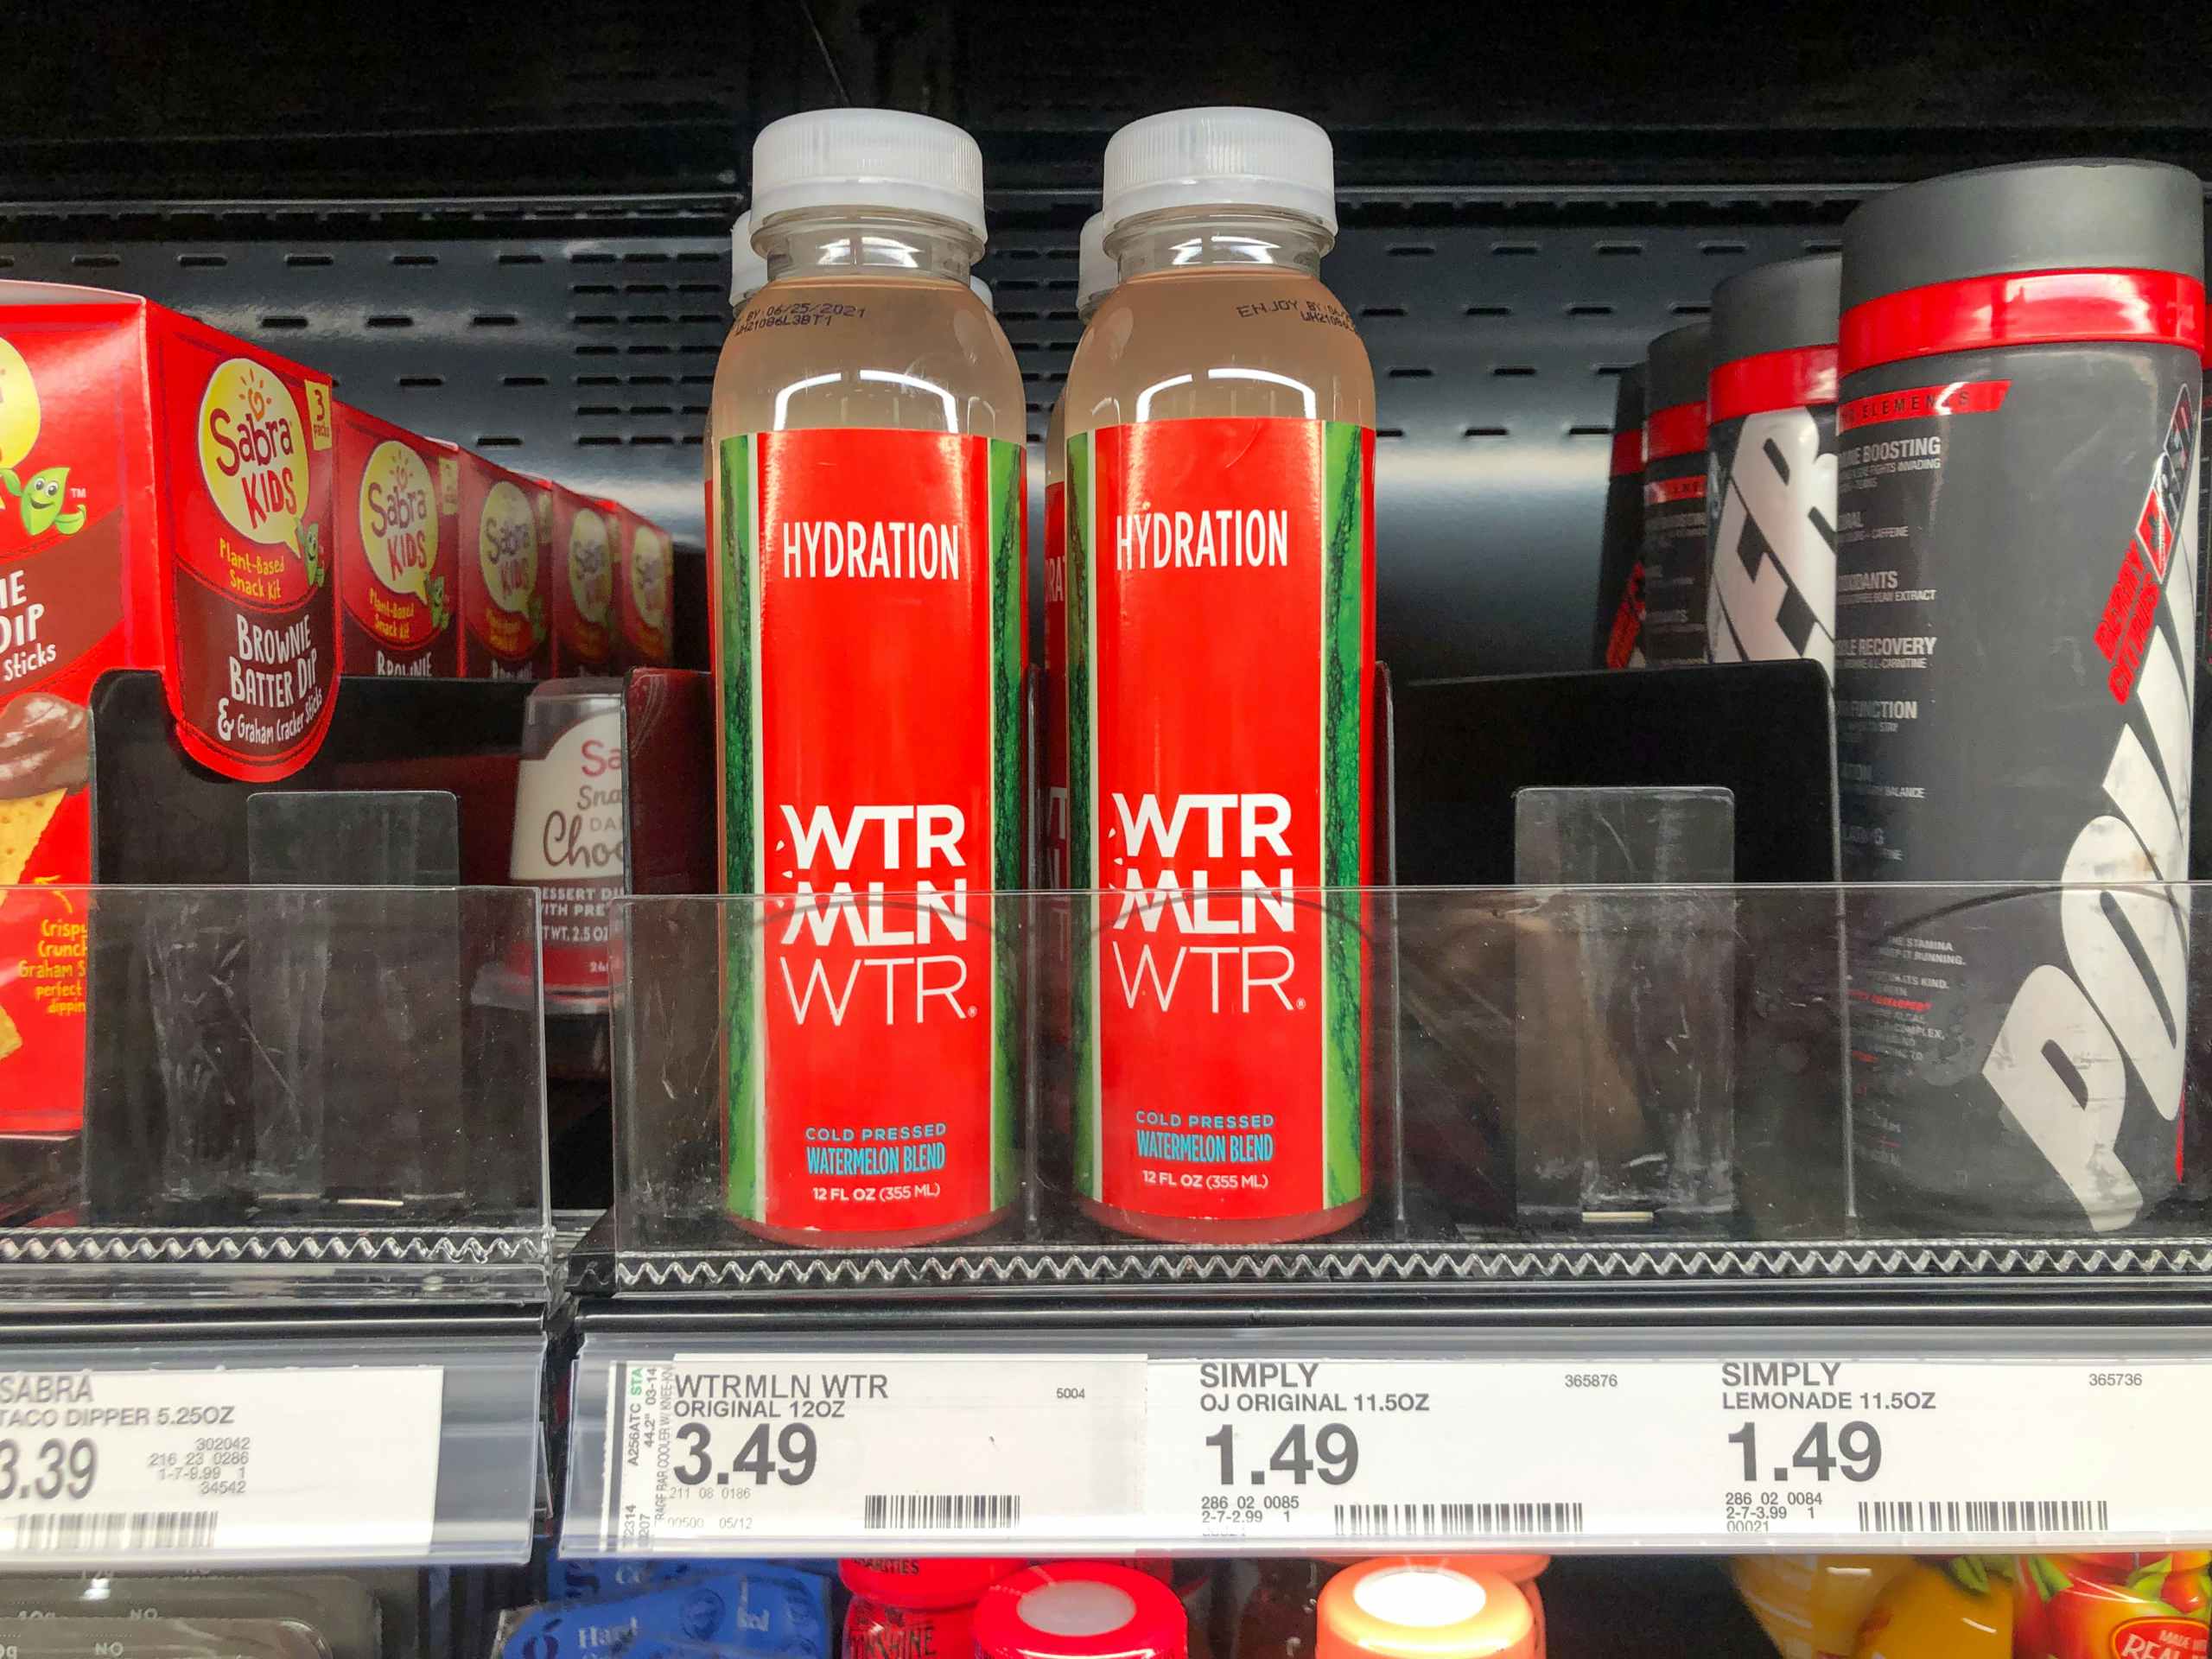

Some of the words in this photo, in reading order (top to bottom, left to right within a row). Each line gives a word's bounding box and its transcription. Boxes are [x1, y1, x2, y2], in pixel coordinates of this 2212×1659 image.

[1236, 300, 1299, 317] ENJOY
[315, 389, 325, 422] 3
[210, 408, 294, 477] Sabra
[1863, 436, 1941, 463] BOOSTING
[242, 467, 297, 530] KIDS
[368, 482, 428, 538] Sabra
[782, 520, 960, 581] HYDRATION
[1116, 508, 1288, 571] HYDRATION
[219, 537, 285, 575] Plant-Based
[387, 530, 427, 582] KIDS
[230, 569, 264, 599] Snack
[267, 579, 282, 601] Kit
[1894, 589, 1937, 602] EXTRACT
[2094, 539, 2145, 663] BERRY
[1859, 637, 1938, 656] RECOVERY
[3, 642, 57, 682] Sticks
[218, 697, 235, 741] &
[238, 713, 274, 745] Graham
[276, 705, 304, 741] Cracker
[1111, 791, 1293, 858] WTR
[780, 804, 966, 870] WTR
[541, 887, 596, 900] ESSERT
[1111, 868, 1294, 935] MLN
[541, 903, 569, 916] ITH
[574, 903, 608, 917] PRE
[780, 878, 967, 947] MLN
[572, 925, 590, 943] 2.5
[1907, 938, 1954, 951] STAMINA
[18, 960, 73, 978] Graham
[1914, 952, 1967, 965] RUNNING.
[1112, 940, 1295, 1014] WTR
[35, 980, 82, 1001] perfect
[779, 954, 970, 1027] WTR
[1135, 1110, 1181, 1127] COLD
[1189, 1115, 1274, 1128] PRESSED
[805, 1128, 855, 1141] COLD
[861, 1122, 947, 1141] PRESSED
[1136, 1129, 1226, 1162] WATERMELON
[1230, 1133, 1273, 1162] BLEND
[806, 1146, 899, 1175] WATERMELON
[903, 1142, 946, 1173] BLEND
[1142, 1170, 1156, 1184] 12
[1159, 1173, 1176, 1186] FL
[1180, 1173, 1204, 1188] OZ
[1205, 1174, 1237, 1190] (355
[1241, 1174, 1268, 1189] ML)
[812, 1186, 827, 1201] 12
[830, 1187, 849, 1201] FL
[853, 1187, 876, 1201] OZ
[879, 1186, 912, 1202] (355
[914, 1183, 941, 1198] ML)
[631, 1368, 643, 1396] STA
[1200, 1363, 1319, 1388] SIMPLY
[1565, 1374, 1618, 1388] 365876
[1721, 1362, 1841, 1386] SIMPLY
[2088, 1373, 2143, 1386] 365736
[0, 1375, 94, 1403] SABRA
[645, 1368, 657, 1405] 03-14
[674, 1374, 810, 1399] WTRMLN
[822, 1374, 888, 1399] WTR
[1056, 1388, 1085, 1399] 5004
[674, 1400, 781, 1418] ORIGINAL
[789, 1400, 846, 1418] 12OZ
[1200, 1394, 1229, 1411] OJ
[1236, 1393, 1347, 1411] ORIGINAL
[1353, 1394, 1430, 1411] 11.5OZ
[1722, 1392, 1853, 1410] LEMONADE
[1859, 1392, 1936, 1409] 11.5OZ
[0, 1408, 60, 1427] TACO
[66, 1408, 149, 1426] DIPPER
[157, 1406, 235, 1426] 5.25OZ
[195, 1438, 251, 1451] 302042
[658, 1427, 670, 1469] COOLER
[673, 1421, 817, 1485] 3.49
[1205, 1422, 1359, 1485] 1.49
[1727, 1421, 1882, 1482] 1.49
[0, 1438, 99, 1500] 3.39
[149, 1453, 177, 1466] 216
[186, 1452, 204, 1465] 23
[213, 1452, 249, 1465] 0286
[239, 1466, 245, 1478] 1
[200, 1480, 246, 1494] 34542
[669, 1488, 690, 1499] 211
[699, 1488, 714, 1499] 08
[721, 1487, 751, 1499] 0186
[1201, 1497, 1228, 1510] 286
[1236, 1497, 1253, 1510] 02
[1263, 1496, 1300, 1510] 0085
[1725, 1492, 1752, 1505] 286
[1761, 1492, 1778, 1505] 02
[1787, 1492, 1822, 1505] 0084
[719, 1517, 753, 1529] 05/12
[1202, 1511, 1262, 1523] 2-7-2.99
[1283, 1510, 1290, 1522] 1
[1726, 1506, 1787, 1519] 2-7-3.99
[1807, 1506, 1815, 1519] 1
[94, 1642, 124, 1657] NO
